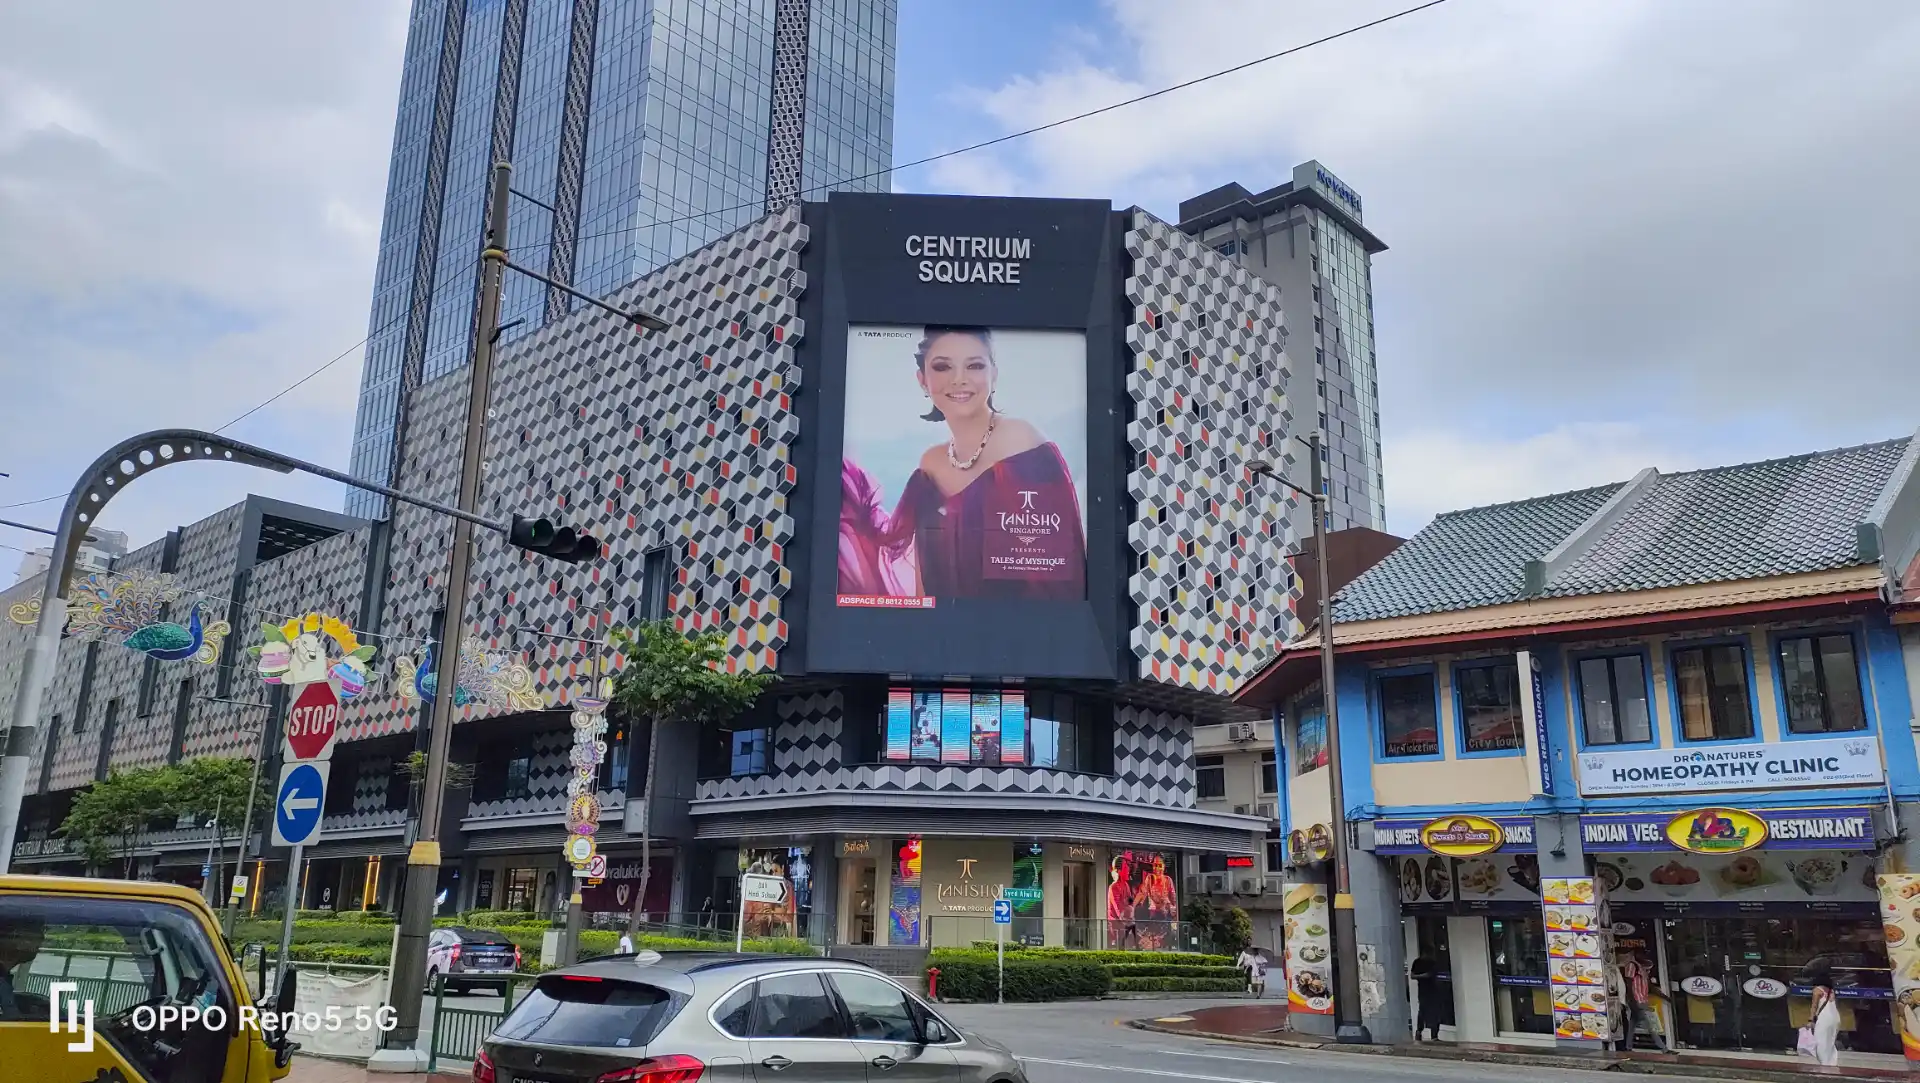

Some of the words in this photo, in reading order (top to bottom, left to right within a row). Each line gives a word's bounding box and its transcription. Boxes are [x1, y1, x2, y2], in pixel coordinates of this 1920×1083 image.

[905, 234, 1031, 259] CENTRIUM
[918, 260, 1020, 284] SQUARE
[996, 510, 1061, 533] TANISHQ
[1009, 527, 1051, 535] SINGAPORE
[990, 556, 1015, 564] TALES
[1015, 556, 1025, 565] of
[1025, 557, 1066, 566] MYSTIQUE
[290, 703, 336, 737] STOP
[1534, 675, 1548, 759] RESTAURANT
[1612, 760, 1760, 783] HOMEOPATHY
[1765, 757, 1840, 775] CLINIC
[1374, 829, 1395, 845] INDIAN
[1395, 828, 1419, 845] SWEETS
[1504, 826, 1532, 844] SNACKS
[1584, 823, 1628, 842] INDIAN
[1632, 823, 1664, 842] VEG.
[1769, 816, 1865, 840] RESTAURANT
[1004, 888, 1018, 898] Syed
[1033, 890, 1041, 899] Rd
